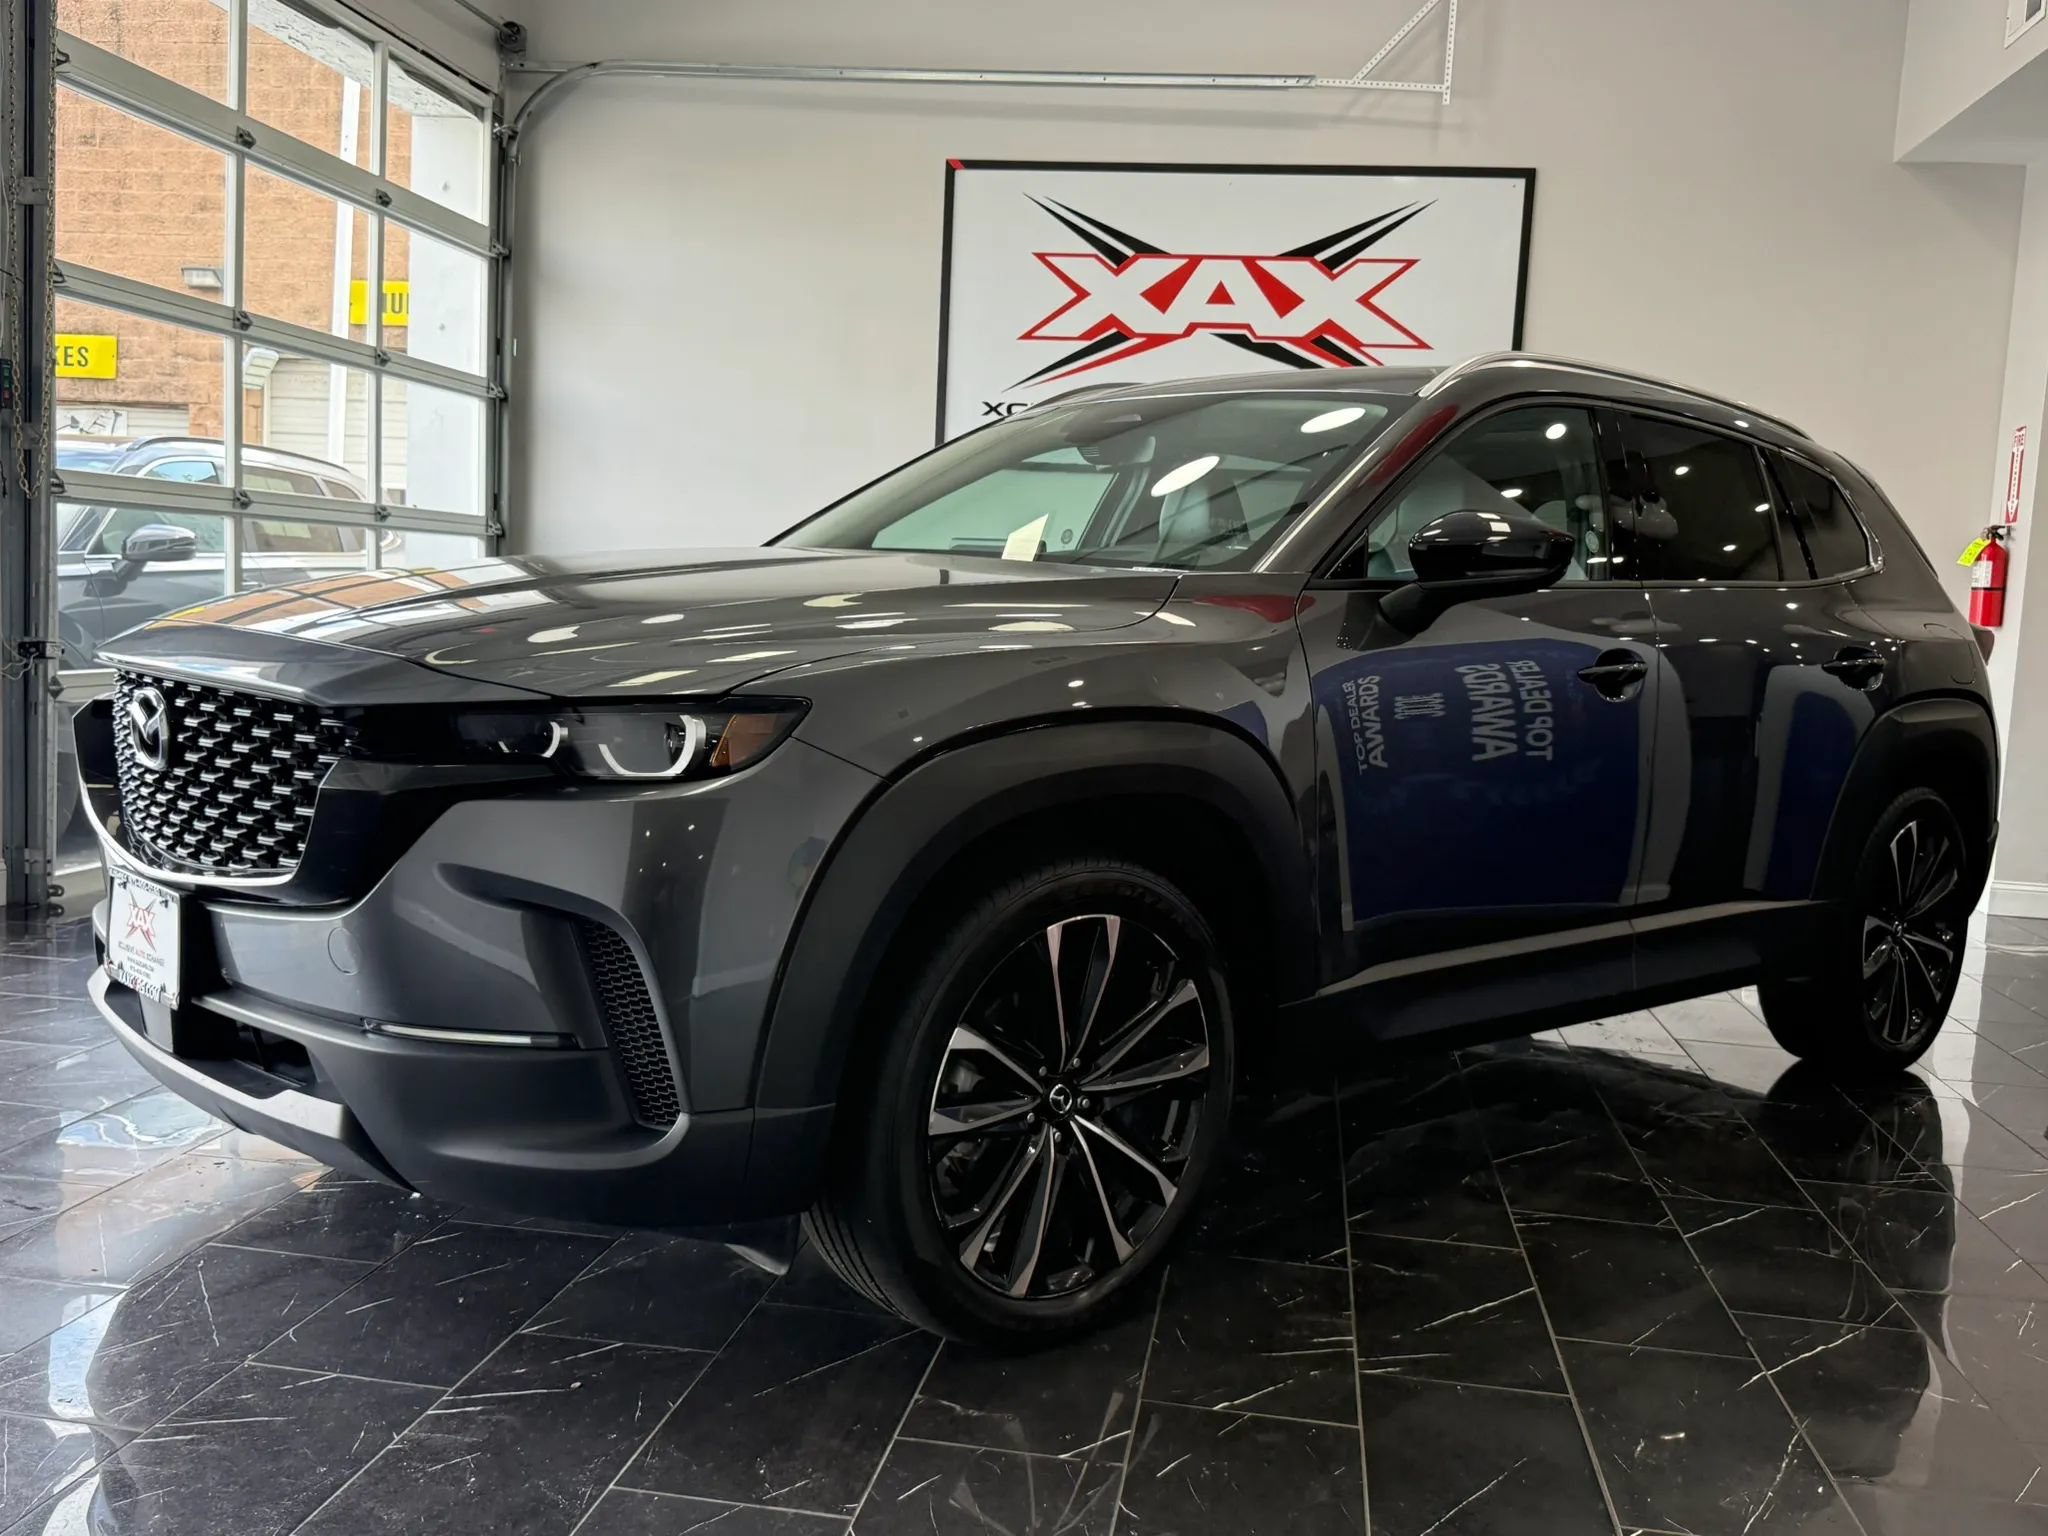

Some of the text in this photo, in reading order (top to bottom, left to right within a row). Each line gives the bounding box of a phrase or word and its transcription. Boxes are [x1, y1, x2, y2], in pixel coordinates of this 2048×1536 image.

[1017, 252, 1435, 350] XAX
[981, 401, 1032, 416] XC
[1342, 680, 1367, 776] TOP DEALER
[1357, 675, 1388, 768] AWARDS
[127, 904, 156, 935] XAX
